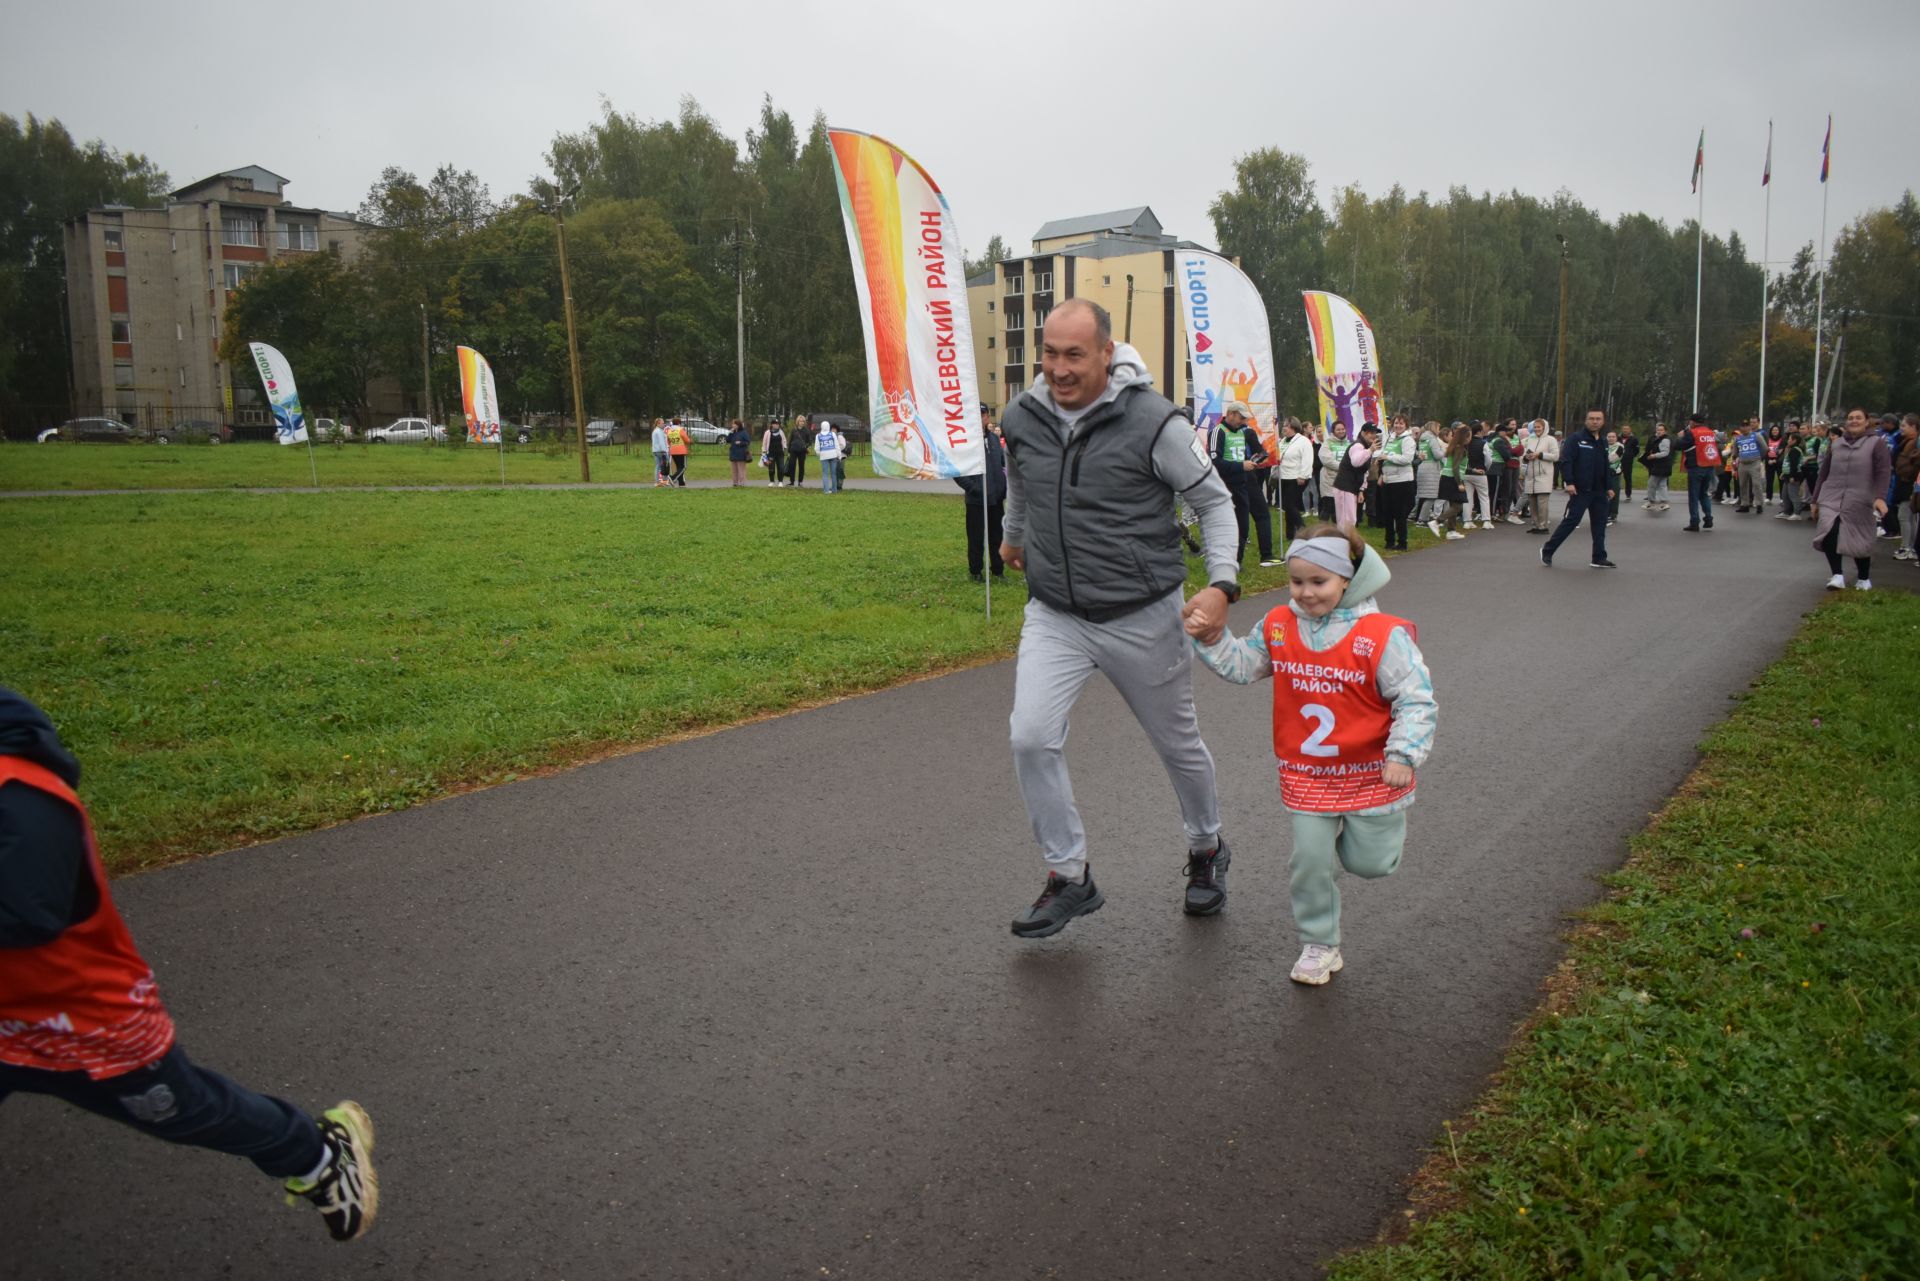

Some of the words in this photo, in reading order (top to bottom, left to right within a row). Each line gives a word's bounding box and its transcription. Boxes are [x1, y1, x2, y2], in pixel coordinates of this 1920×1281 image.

[918, 212, 947, 290] РАЙОН
[1185, 260, 1211, 332] СПОРТ!
[254, 347, 274, 380] СПОРТ!
[925, 299, 966, 449] ТУКАЕВСКИЙ
[1196, 353, 1214, 366] Я
[1271, 660, 1366, 685] ТУКАЕВСКИЙ
[1292, 677, 1344, 694] РАЙОН
[1299, 703, 1340, 758] 2
